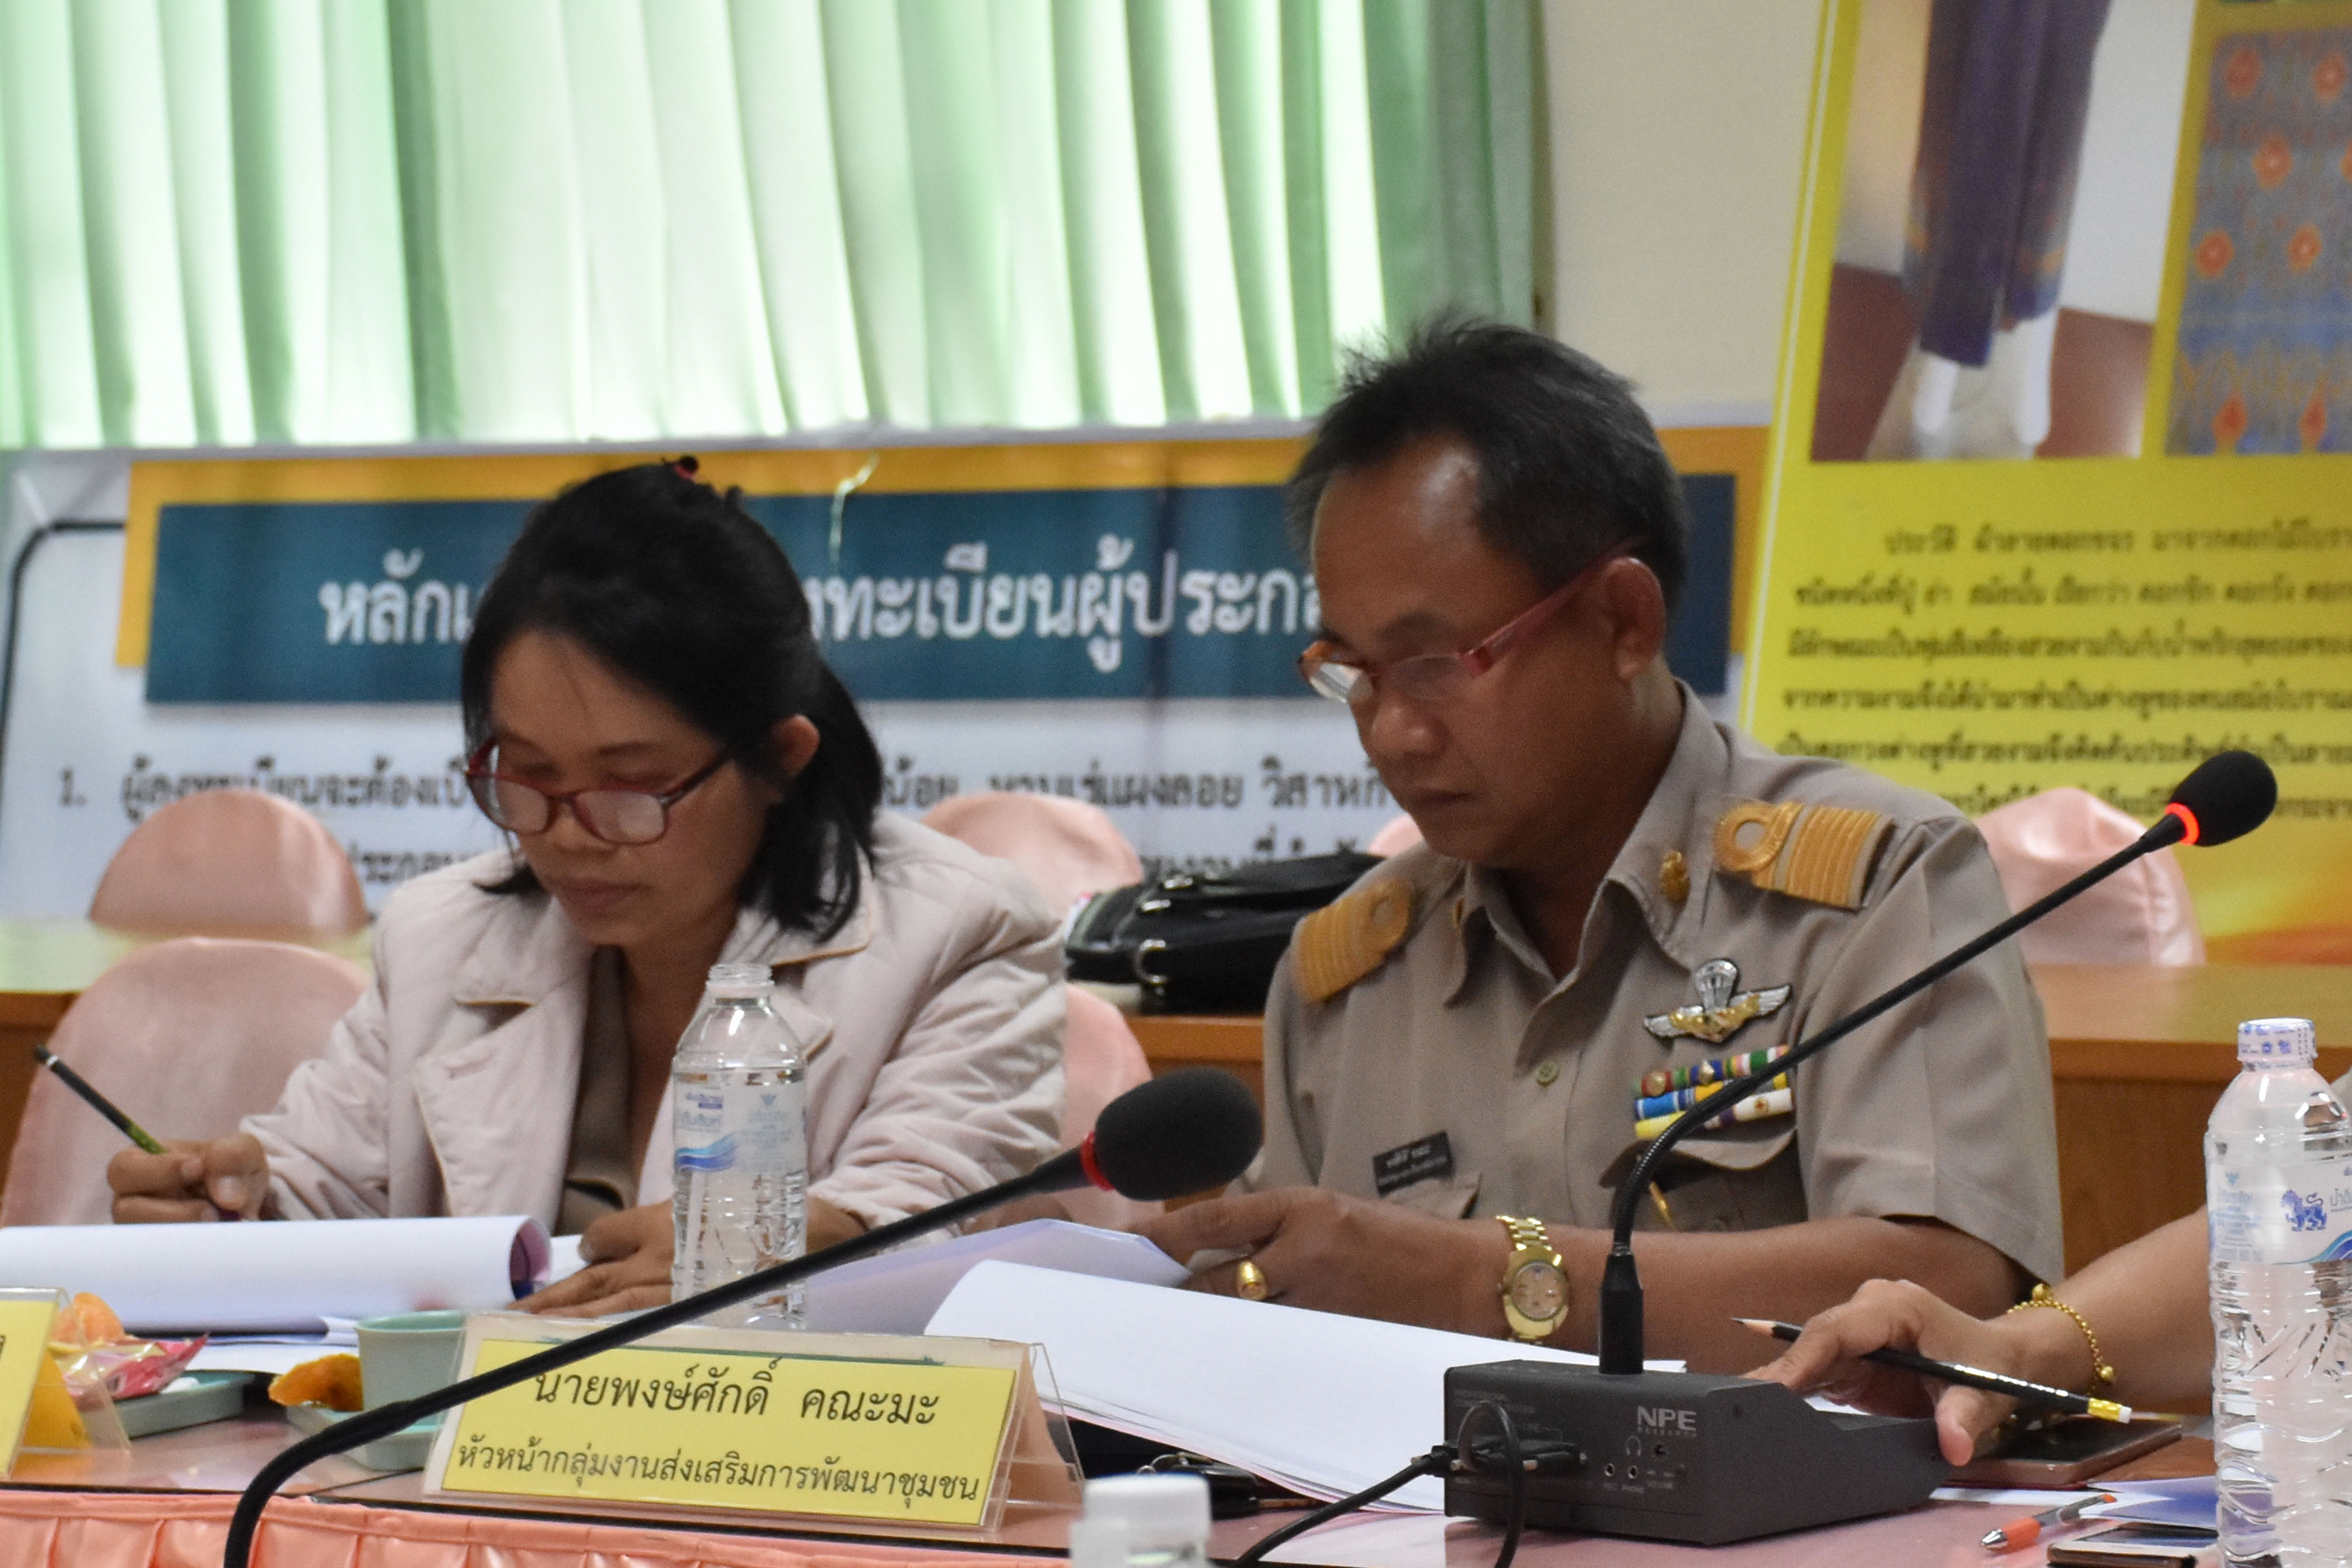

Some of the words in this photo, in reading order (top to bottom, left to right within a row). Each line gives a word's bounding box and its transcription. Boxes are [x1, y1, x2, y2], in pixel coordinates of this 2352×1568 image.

[534, 1357, 782, 1416] นายพงษ์ศักดิ์
[800, 1389, 940, 1424] คณะมะ
[1637, 1406, 1697, 1431] NPE
[458, 1434, 979, 1509] หัวหน้ากลุ่มงานส่งเสริมการพัฒนาชุมชน
